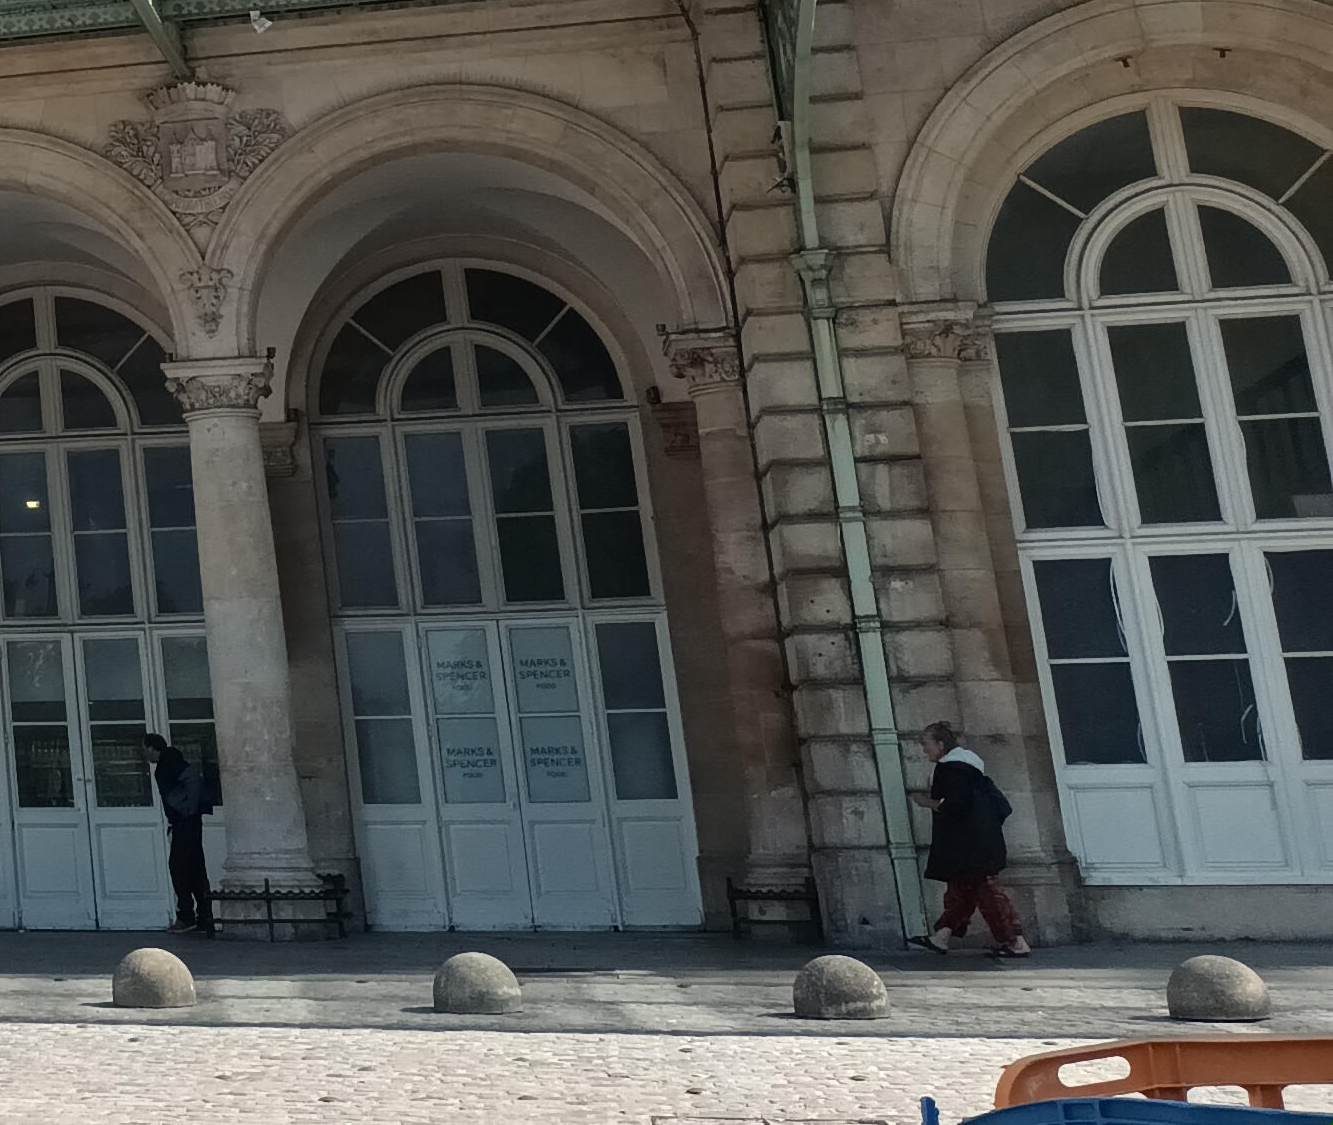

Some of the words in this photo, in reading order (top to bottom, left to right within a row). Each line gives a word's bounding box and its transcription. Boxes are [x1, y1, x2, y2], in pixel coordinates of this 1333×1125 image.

[436, 659, 474, 669] MARKS
[519, 658, 558, 667] MARKS
[435, 671, 487, 681] SPENCER
[519, 669, 571, 680] SPENCER
[446, 747, 485, 757] MARKS
[529, 746, 569, 755] MARKS
[445, 758, 497, 769] SPENCER
[529, 757, 582, 768] SPENCER
